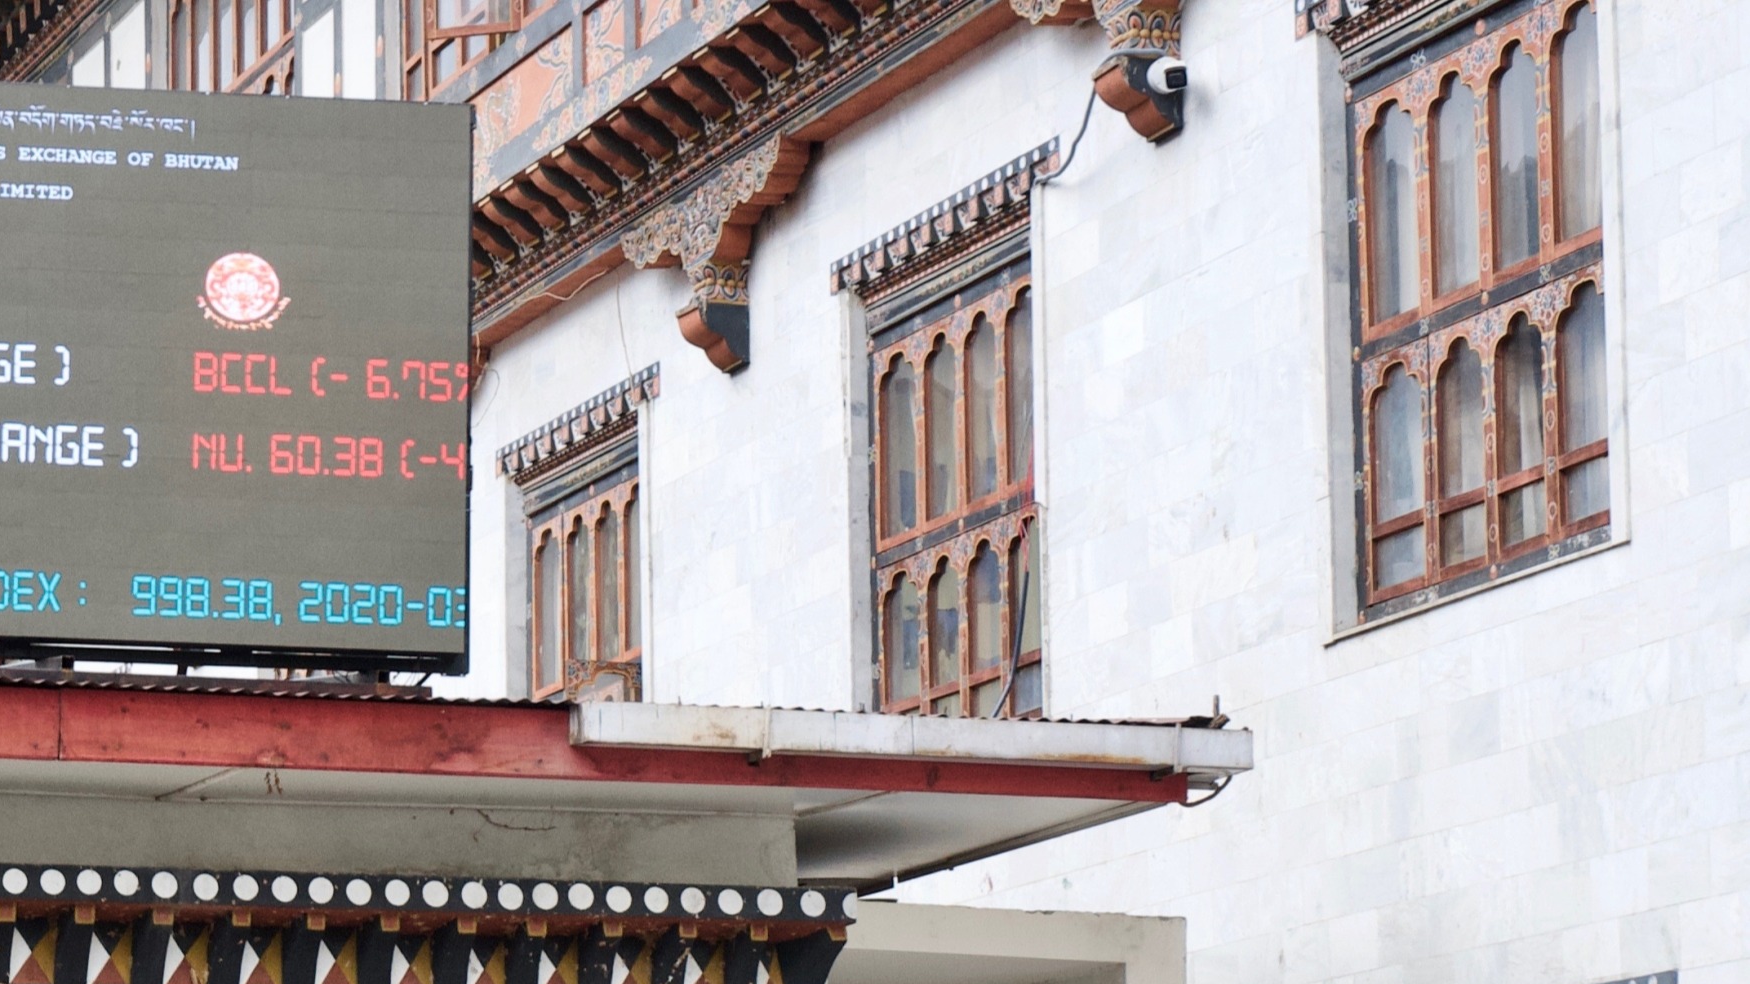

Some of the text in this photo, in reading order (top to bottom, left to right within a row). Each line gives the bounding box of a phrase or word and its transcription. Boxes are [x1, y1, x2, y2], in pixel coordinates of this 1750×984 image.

[19, 147, 116, 164] EXCHANGE
[128, 152, 153, 166] OF
[165, 154, 238, 170] BHUTAN
[193, 351, 292, 396] BCCL
[192, 434, 252, 473] NU.
[269, 433, 384, 479] 60.38
[131, 574, 282, 625] 998.38,
